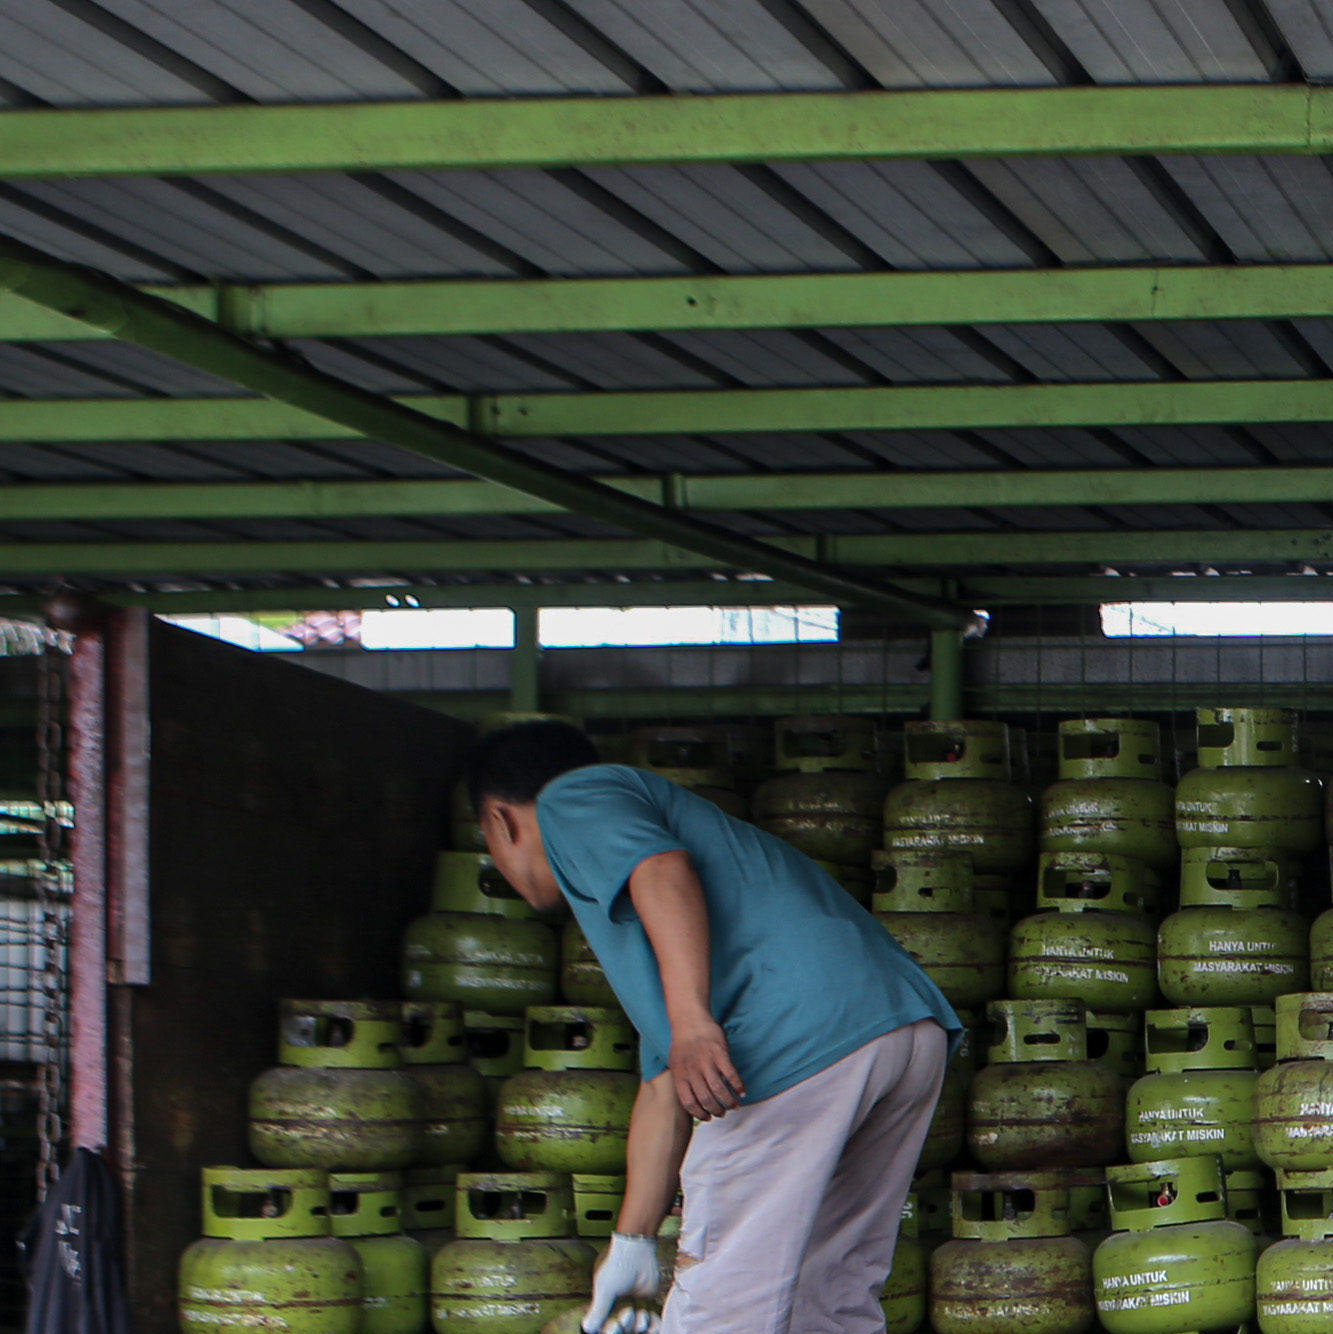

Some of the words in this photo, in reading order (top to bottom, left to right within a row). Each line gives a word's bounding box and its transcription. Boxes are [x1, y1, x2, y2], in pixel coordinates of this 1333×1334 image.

[1209, 941, 1246, 952] HANYA
[1193, 961, 1263, 973] MASYARAKAT
[1167, 1108, 1204, 1120] UNTUK
[1186, 1128, 1225, 1141] MISKIN
[1102, 1275, 1129, 1290] HANYA
[1130, 1270, 1168, 1285] UNTUK
[1150, 1290, 1191, 1307] MISKIN
[1263, 1301, 1321, 1316] MASYARAKAT
